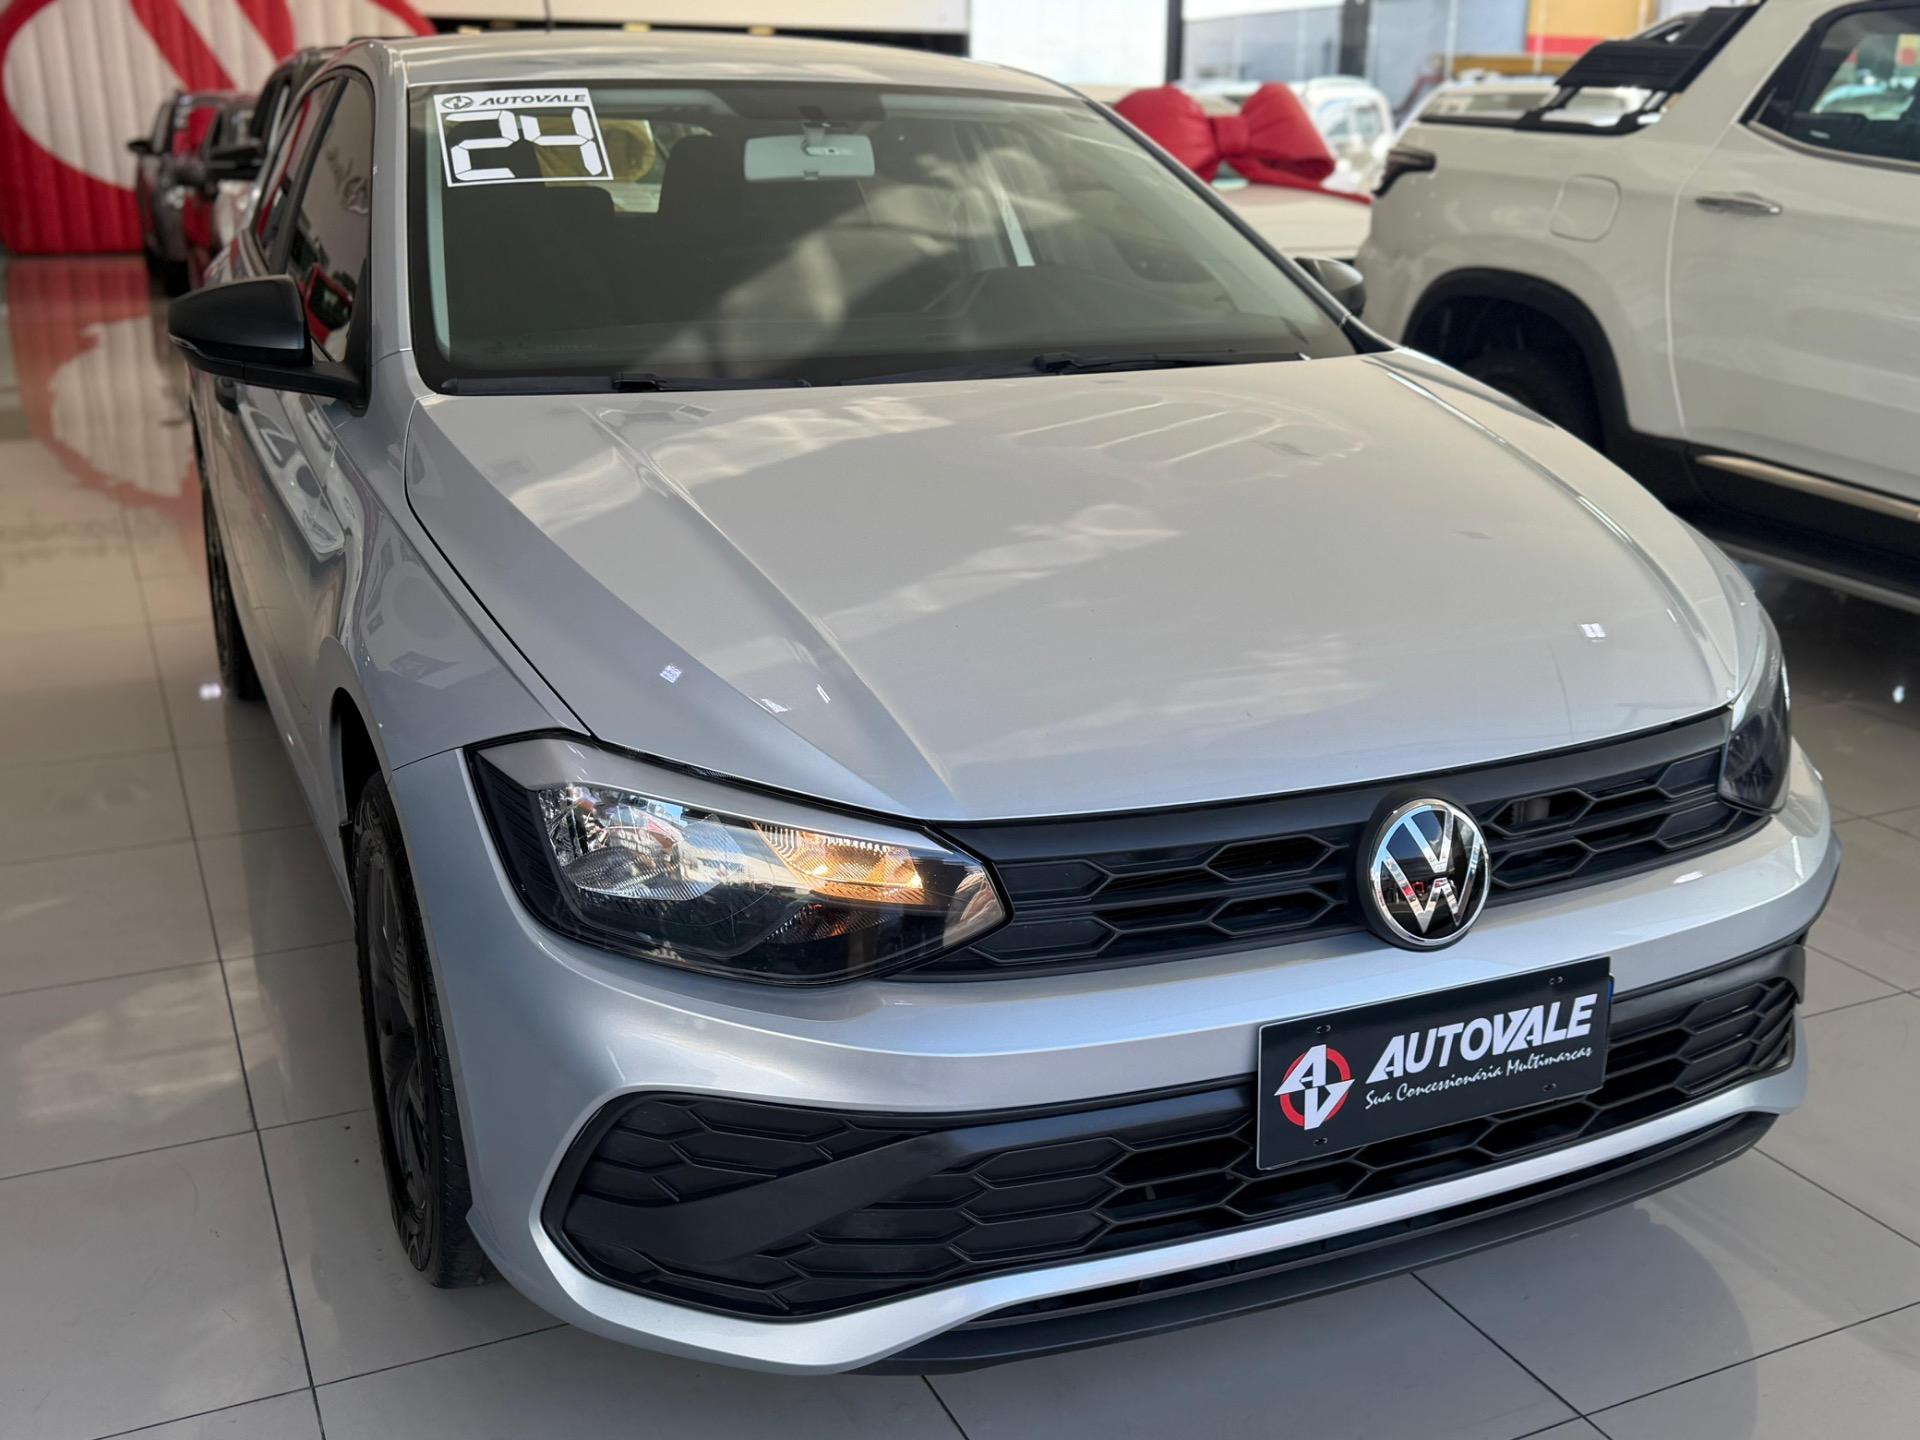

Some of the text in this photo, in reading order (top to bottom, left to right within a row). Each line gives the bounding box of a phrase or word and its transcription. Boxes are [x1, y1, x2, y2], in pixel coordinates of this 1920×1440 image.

[479, 94, 586, 107] AUTOVALE
[445, 107, 603, 181] 24
[1365, 993, 1597, 1084] AUTOVALE
[1365, 1046, 1593, 1110] Sua Concessionária Multimarcas
